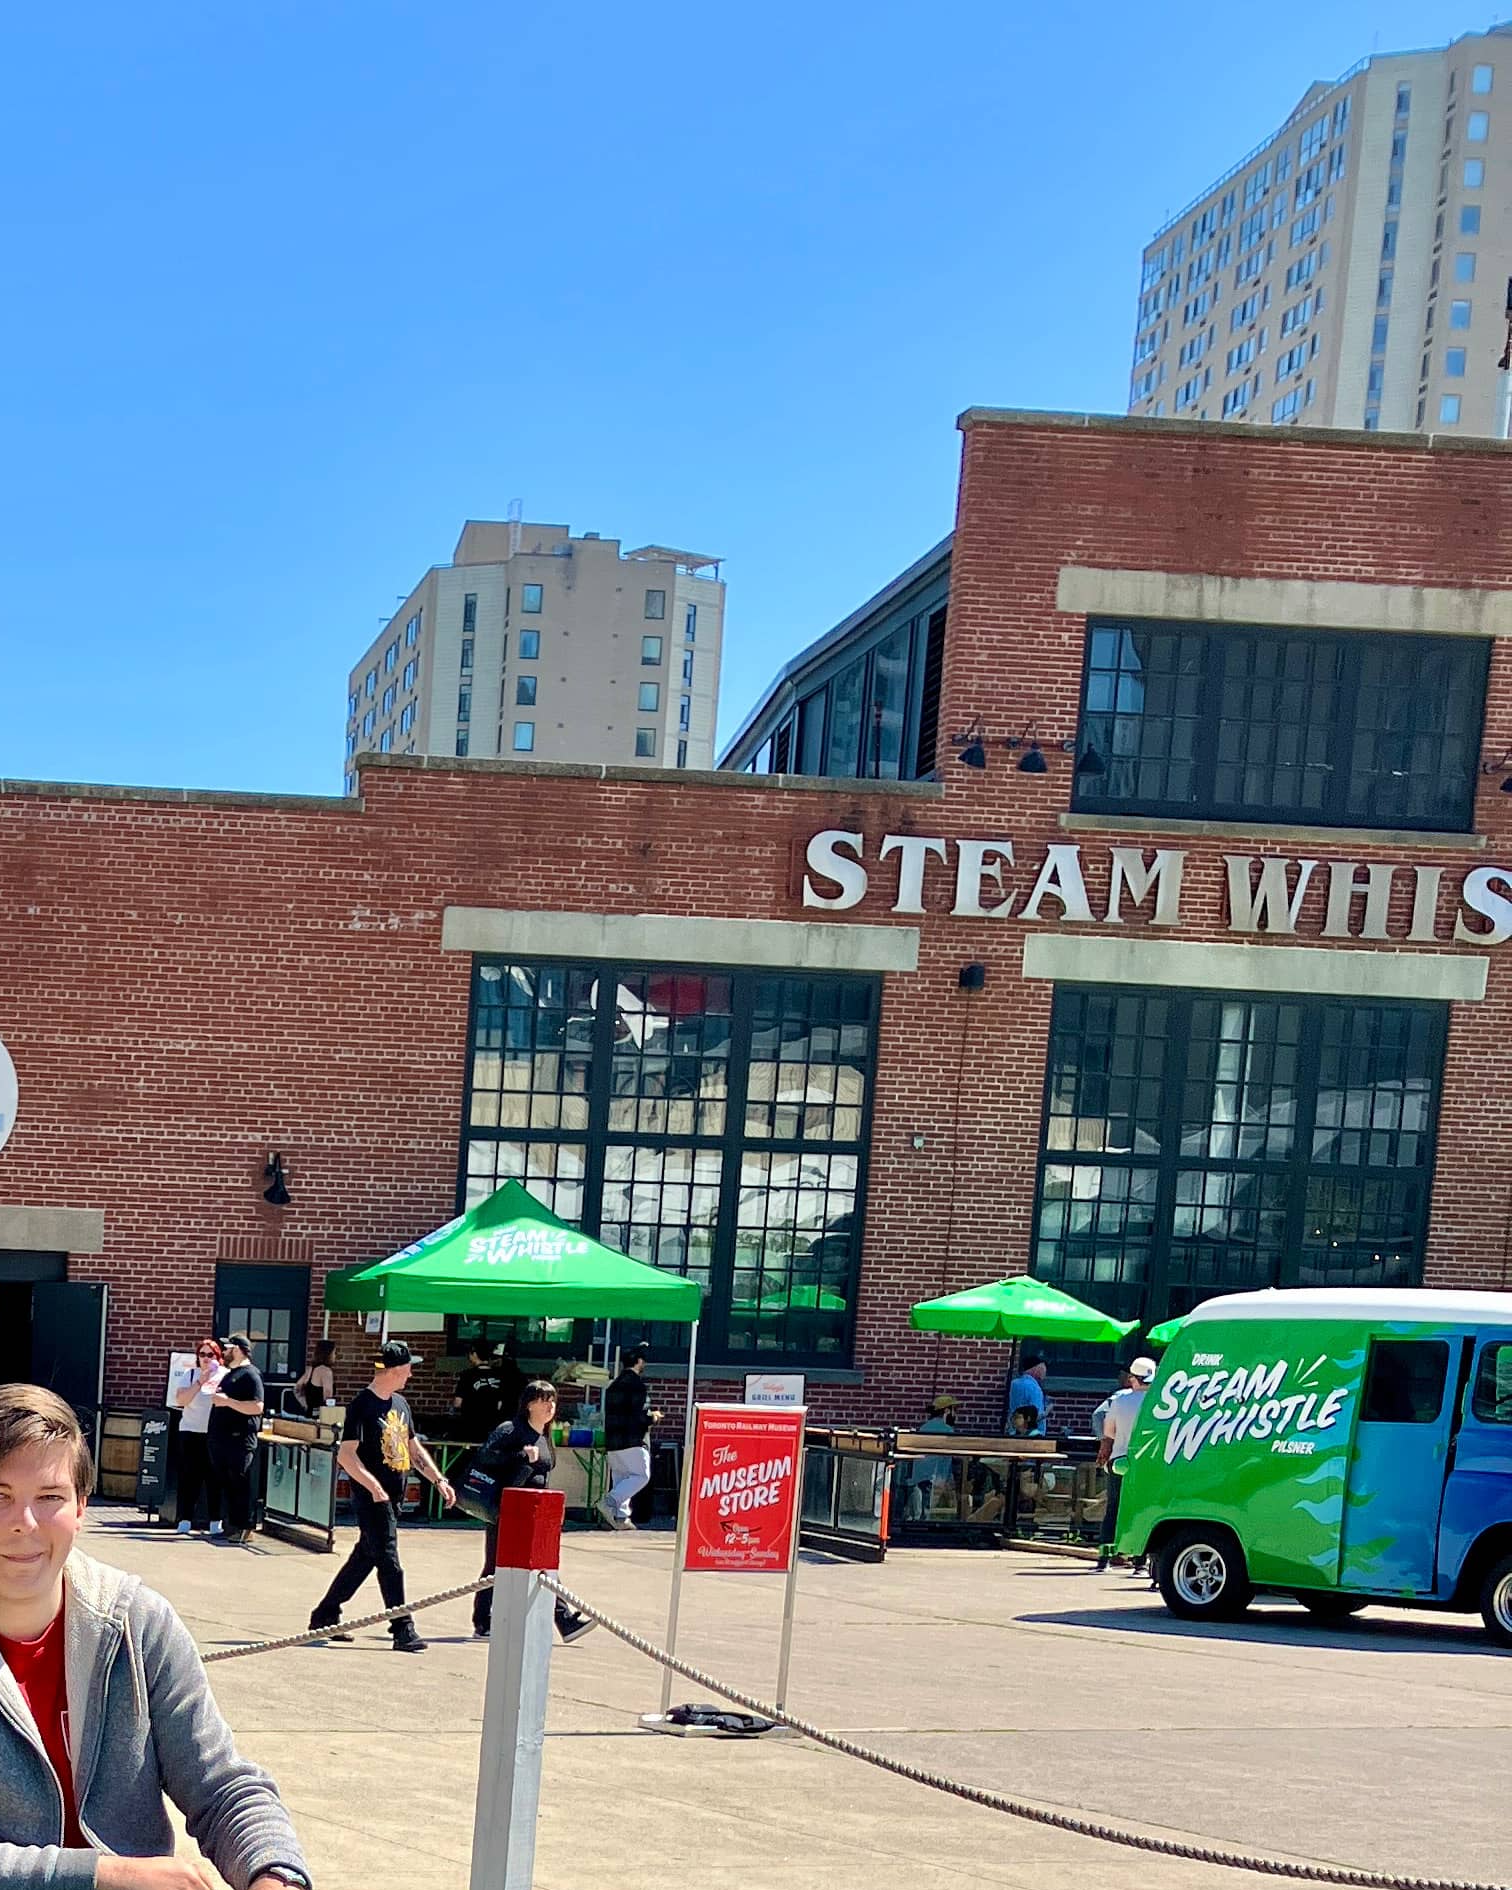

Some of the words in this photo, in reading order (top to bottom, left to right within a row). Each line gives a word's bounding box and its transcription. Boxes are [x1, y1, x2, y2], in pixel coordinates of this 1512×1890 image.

[802, 828, 1188, 926] STEAM
[470, 1229, 548, 1252] STEAM
[1191, 1353, 1224, 1367] DRINK
[1152, 1359, 1289, 1421] STEAM
[1163, 1388, 1349, 1465] WHISTLE
[712, 1444, 738, 1466] The
[1271, 1439, 1316, 1455] PILSNER
[699, 1455, 792, 1499] MUSEUM
[718, 1481, 781, 1517] STORE
